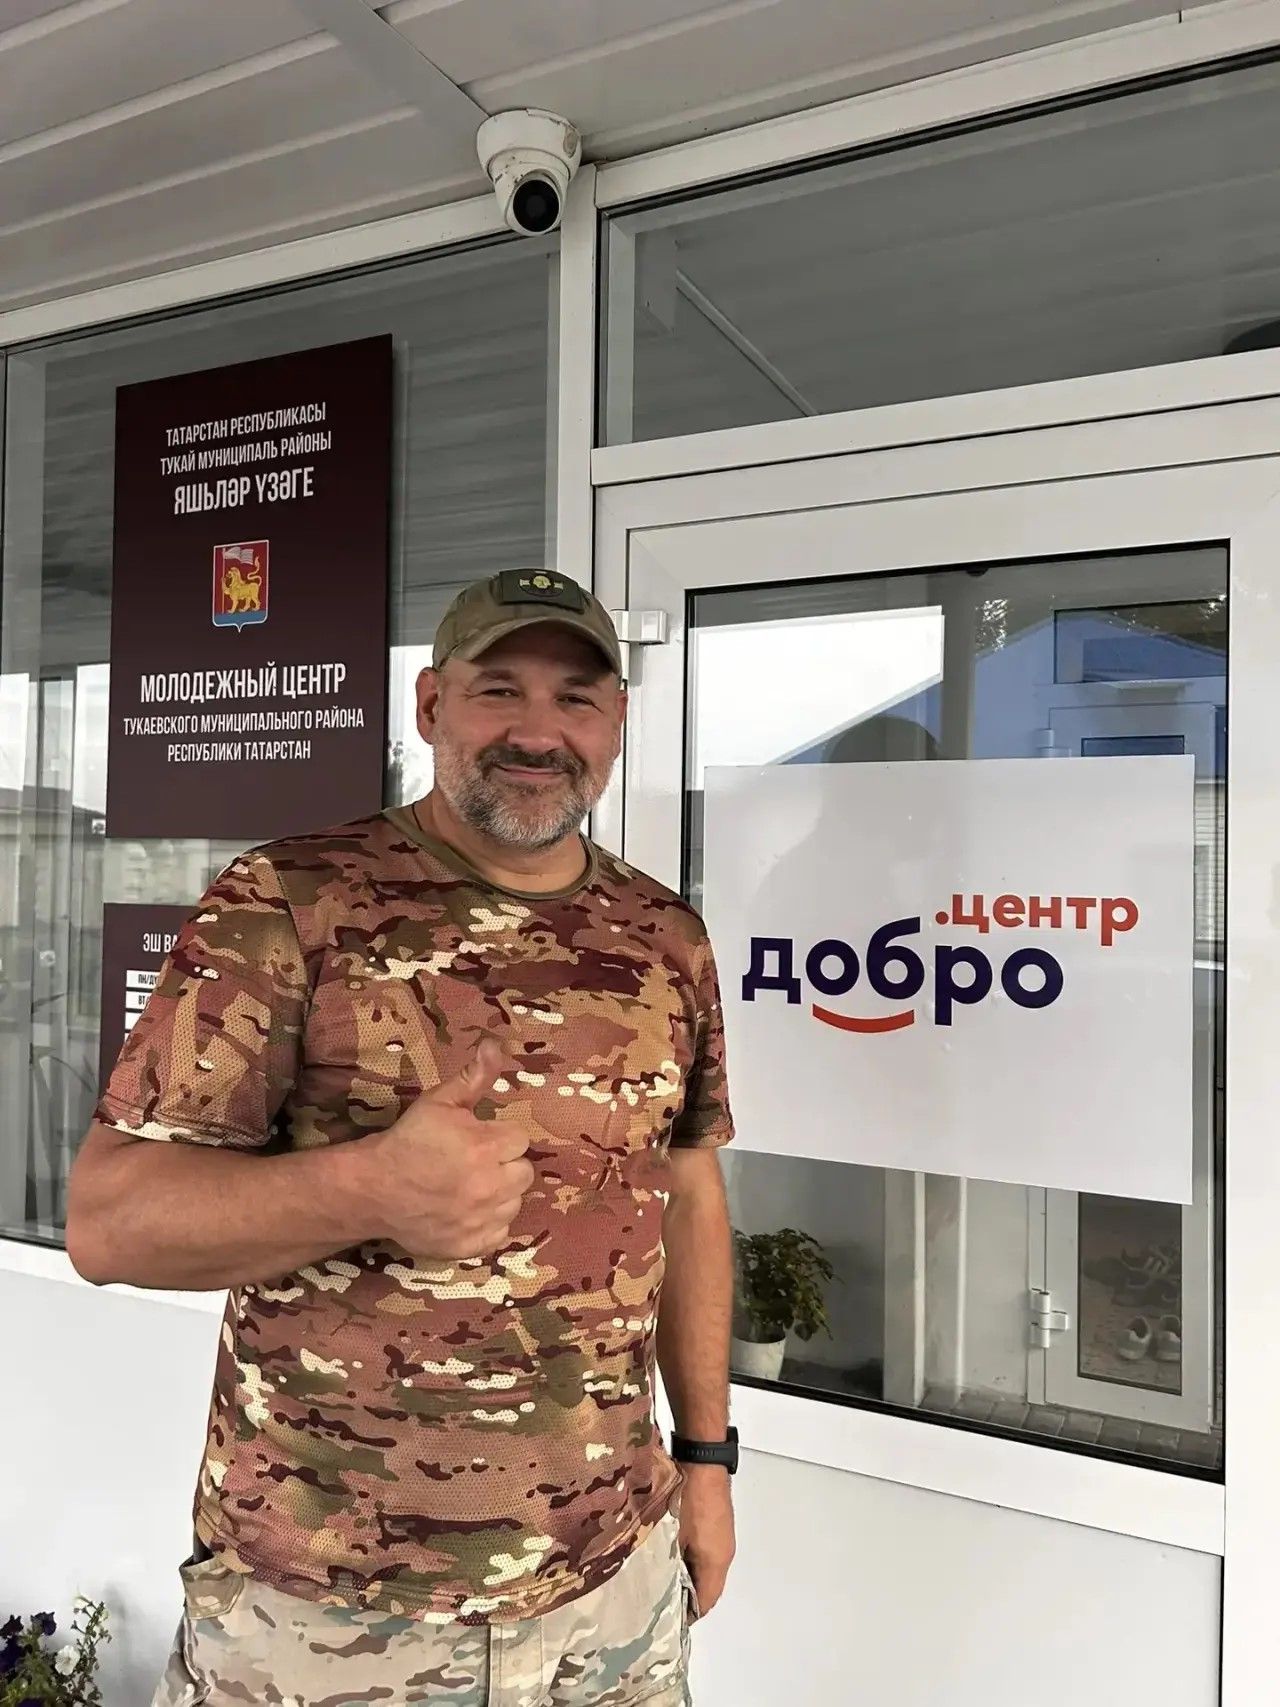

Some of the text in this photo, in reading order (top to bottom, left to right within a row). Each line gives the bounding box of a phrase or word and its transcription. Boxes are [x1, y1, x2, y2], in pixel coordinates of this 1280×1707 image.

[166, 401, 326, 447] ТАТАРСТАН РЕСПУБЛИКАСЫ
[160, 430, 332, 476] ТУКАЙ МУНИЦИПАЛЬ РАЙОНЫ
[174, 466, 315, 515] ЯШЬЛӘР ҮЗӘГЕ
[140, 661, 347, 704] МОЛОДЕЖНЫЙ ЦЕНТР
[123, 705, 365, 736] ТУКАЕВСКОГО МУНИЦИПАЛЬНОГО РАЙОНА
[167, 740, 311, 762] РЕСПУБЛИКИ ТАТАРСТАН
[143, 932, 161, 953] ЭШ
[935, 893, 1139, 946] .центр
[741, 916, 1064, 1026] добро
